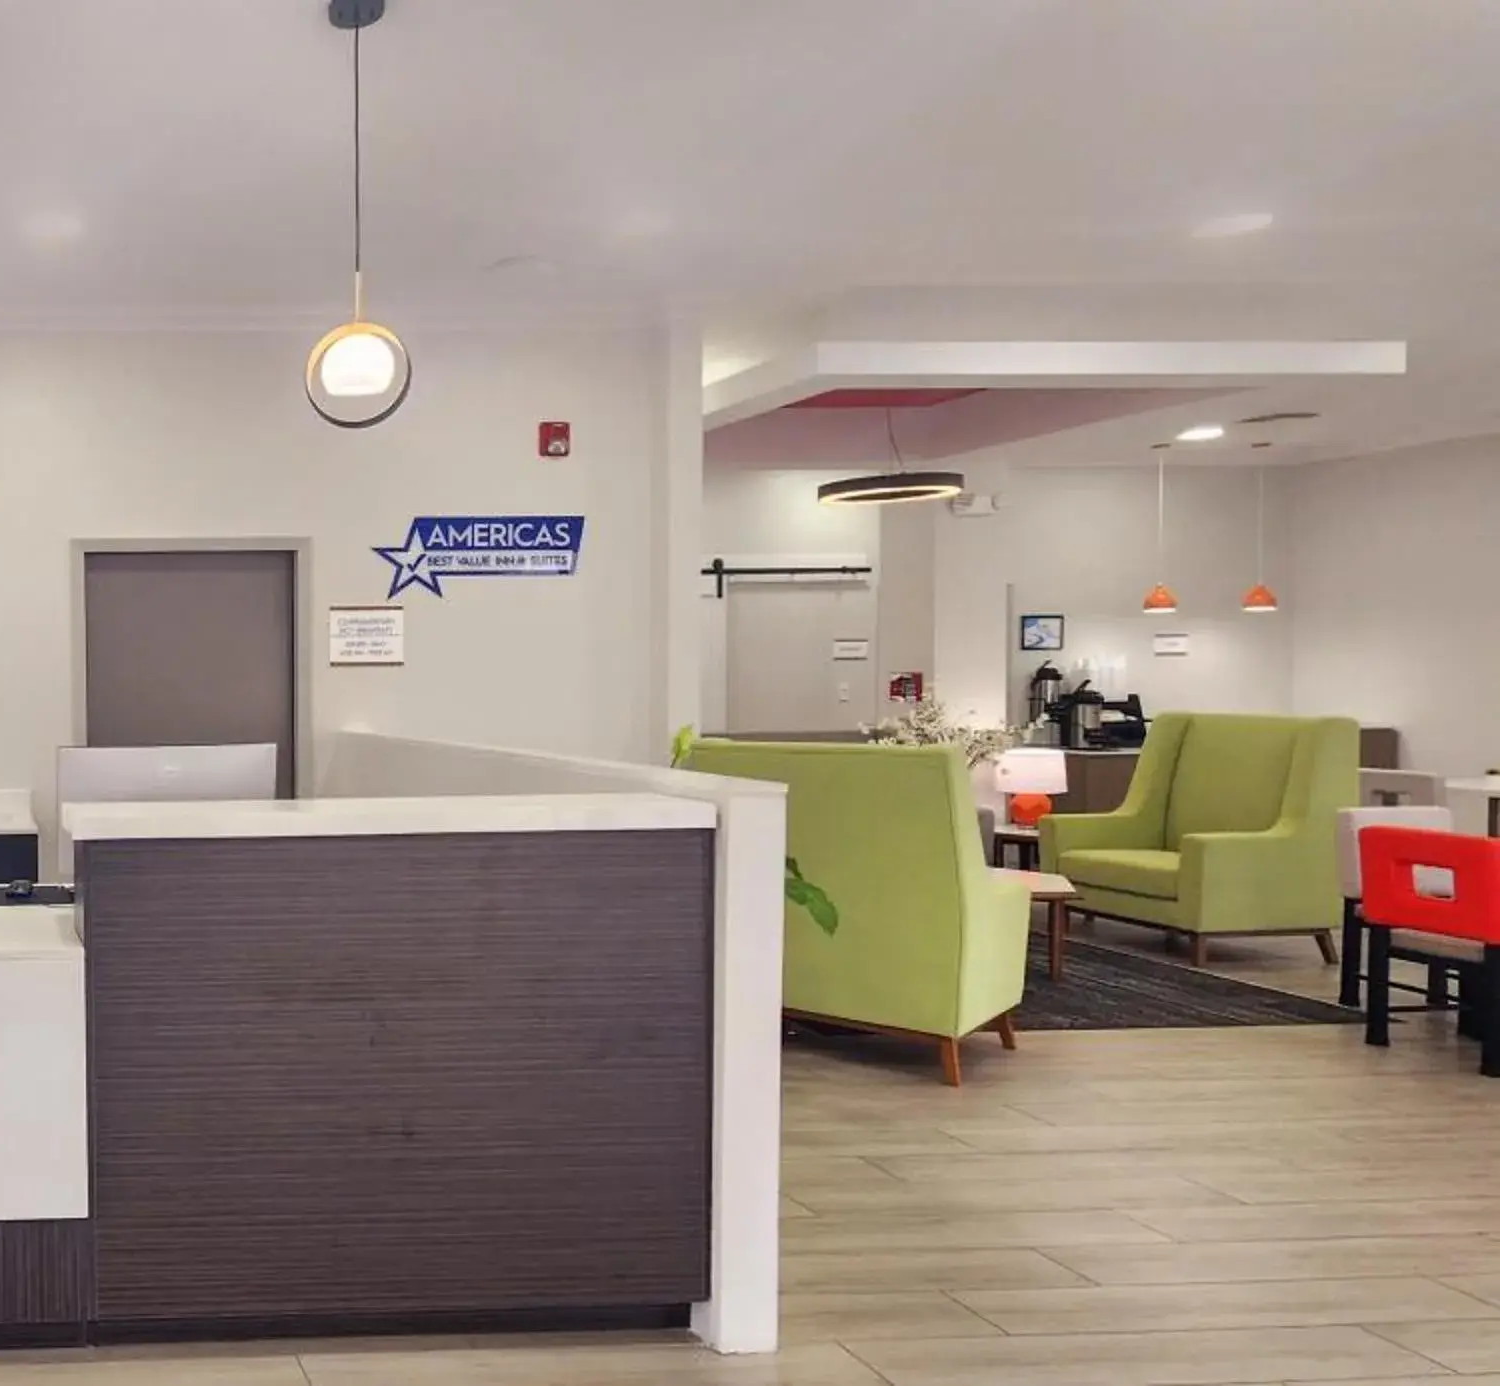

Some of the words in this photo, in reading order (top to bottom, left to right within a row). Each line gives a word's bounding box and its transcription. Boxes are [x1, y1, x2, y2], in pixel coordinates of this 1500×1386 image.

[427, 523, 570, 547] AMERICAS
[428, 554, 454, 567] BEST
[457, 554, 492, 567] VALUE
[530, 554, 568, 567] SUITES
